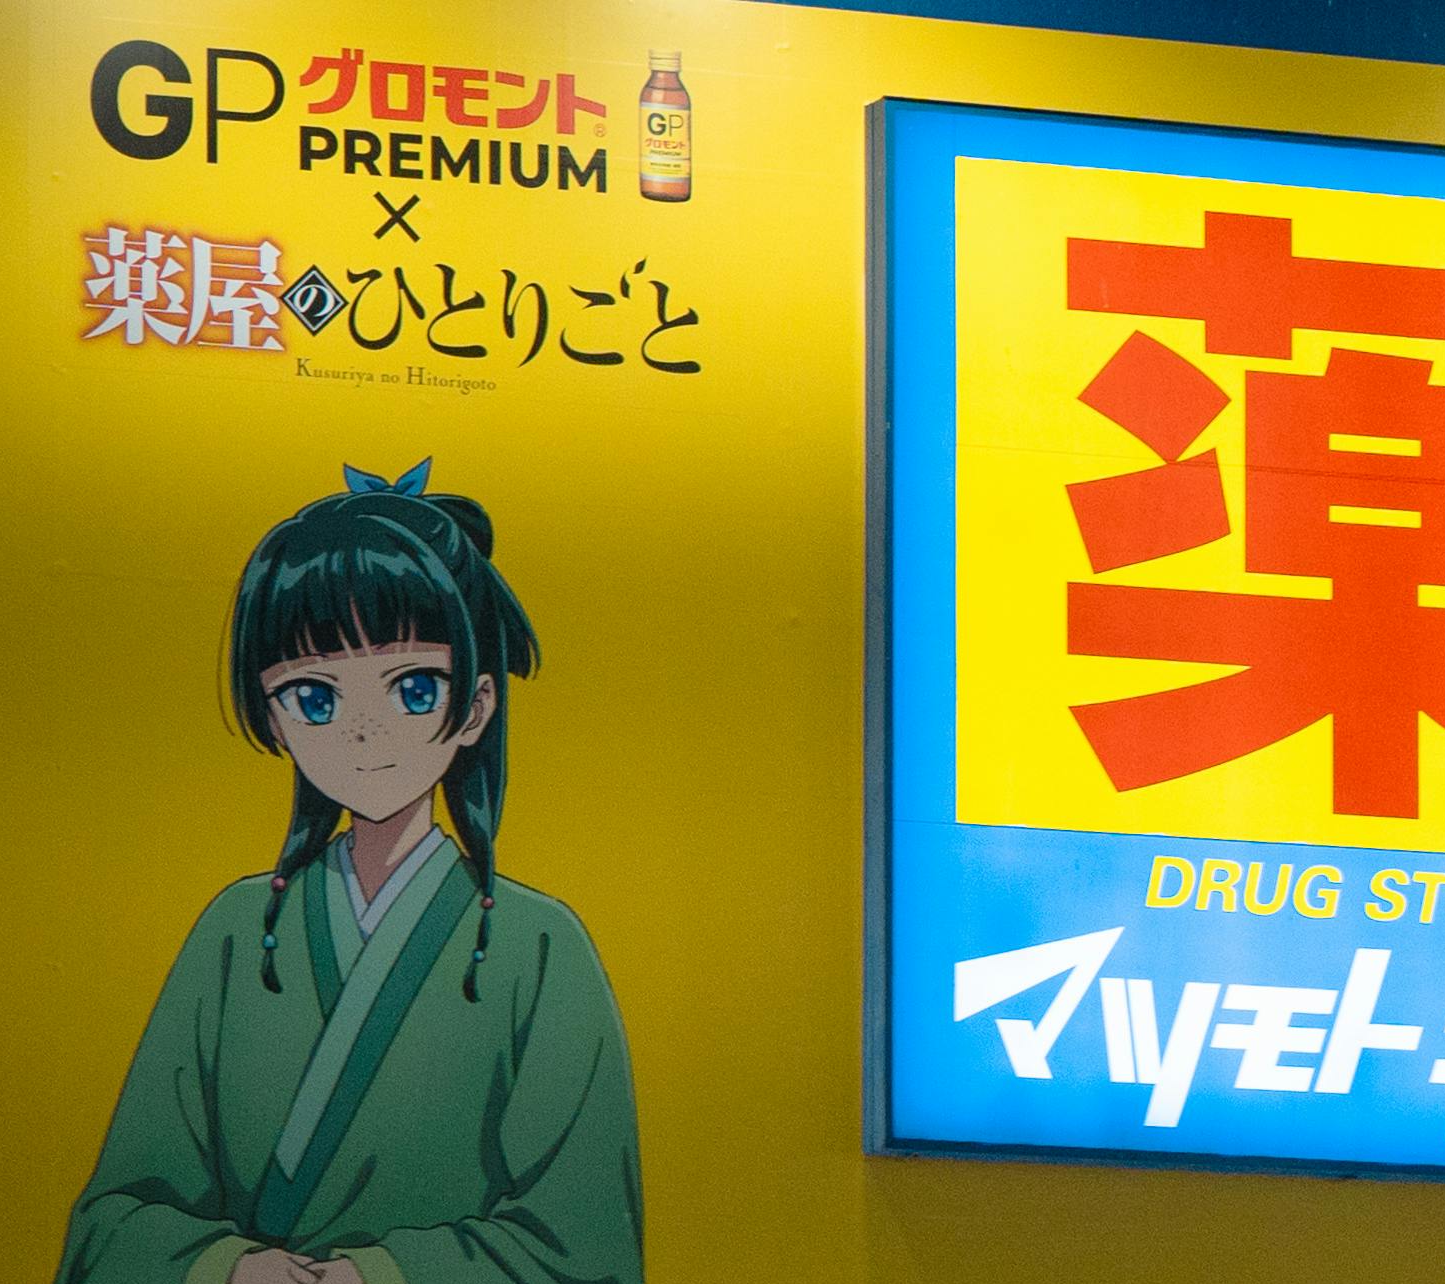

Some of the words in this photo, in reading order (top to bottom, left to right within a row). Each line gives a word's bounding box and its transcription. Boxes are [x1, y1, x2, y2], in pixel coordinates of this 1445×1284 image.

[90, 40, 285, 163] GP
[299, 48, 607, 135] グロモント
[647, 112, 684, 137] GP
[299, 126, 607, 193] PREMIUM
[82, 228, 701, 375] 薬屋のひとりごと
[295, 358, 374, 388] Kusuriya
[380, 373, 401, 385] no
[406, 366, 497, 393] Hitorigoto
[1145, 855, 1343, 920] DRUG
